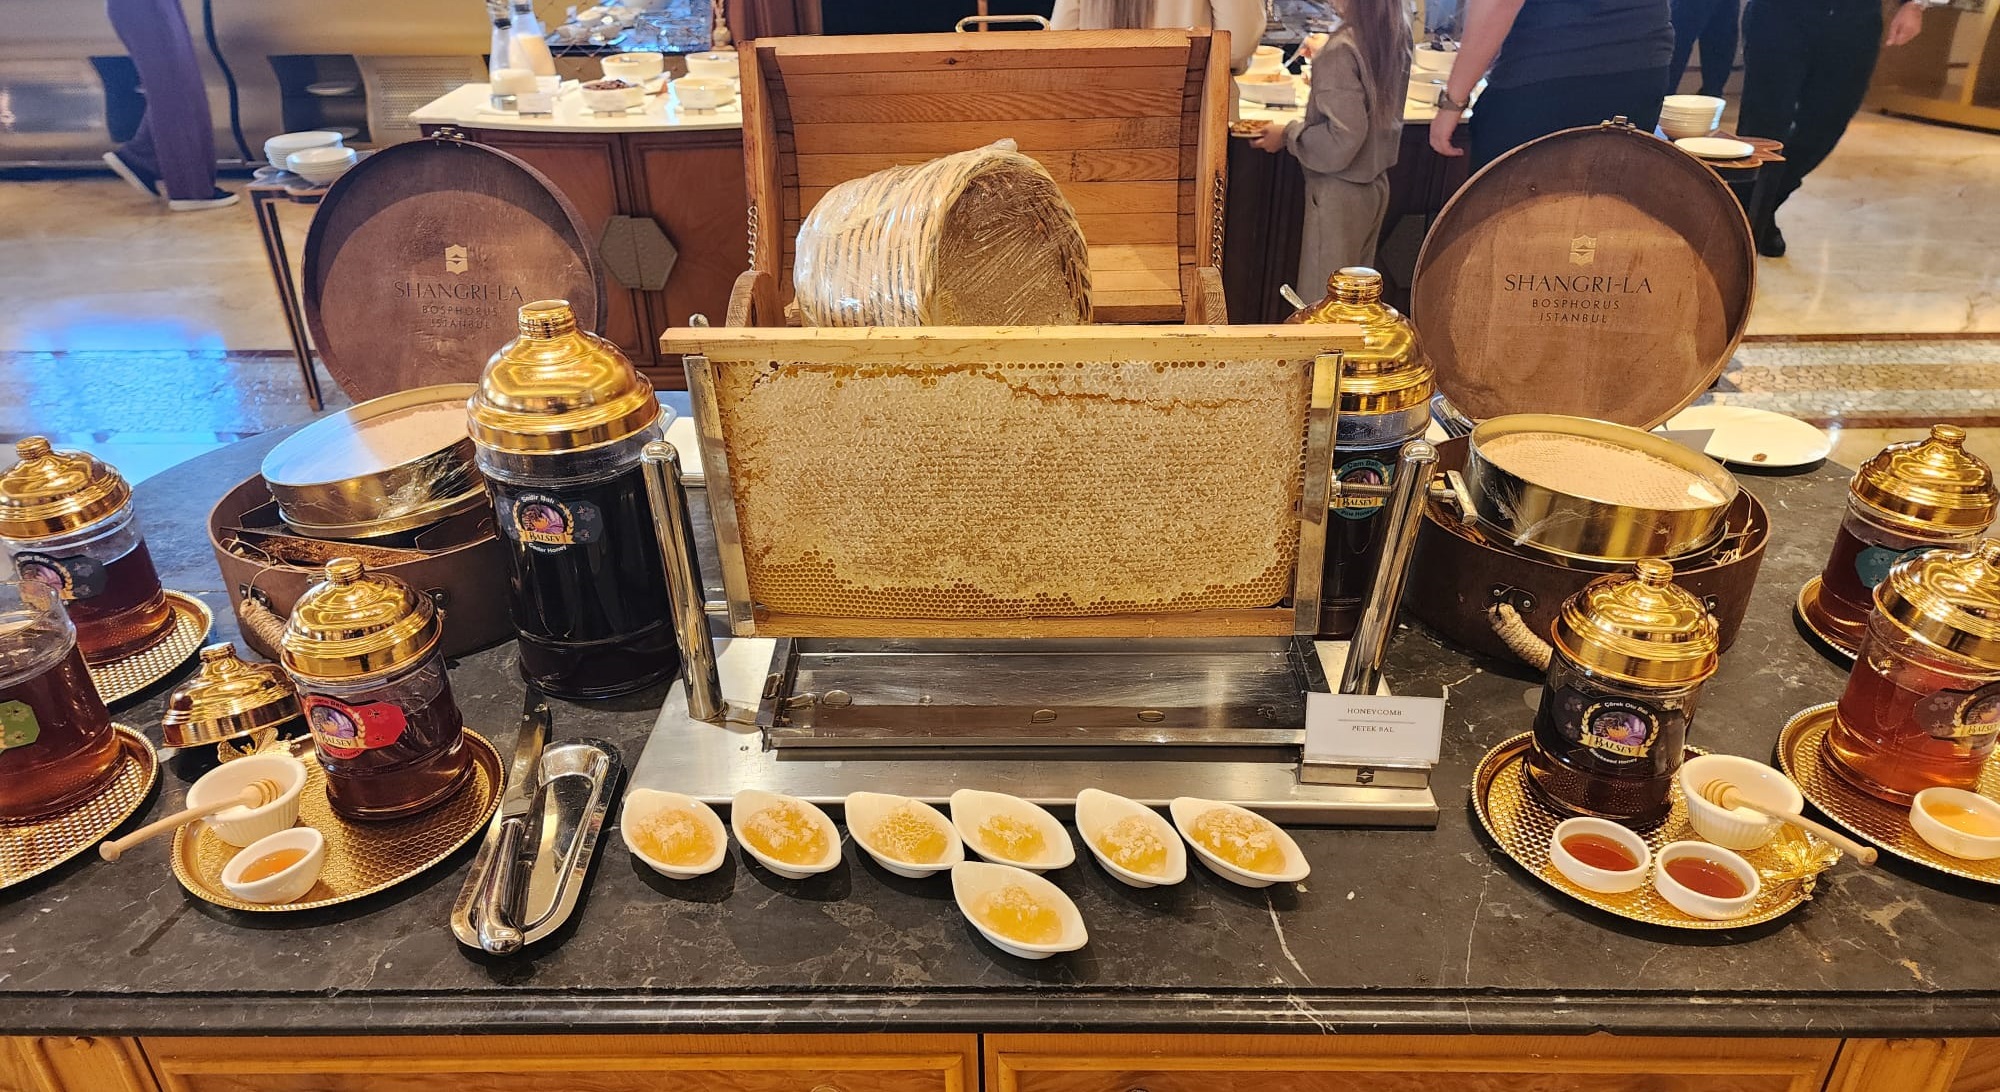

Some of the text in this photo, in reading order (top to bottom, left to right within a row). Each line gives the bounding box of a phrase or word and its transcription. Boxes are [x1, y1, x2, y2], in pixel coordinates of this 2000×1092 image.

[1504, 274, 1652, 294] SHANGRI-LA
[394, 281, 525, 302] SHANGRI-LA
[1532, 298, 1620, 310] BOSPHORUS
[422, 305, 498, 317] BOSPHORUS
[1347, 707, 1402, 716] HONEYCOMB
